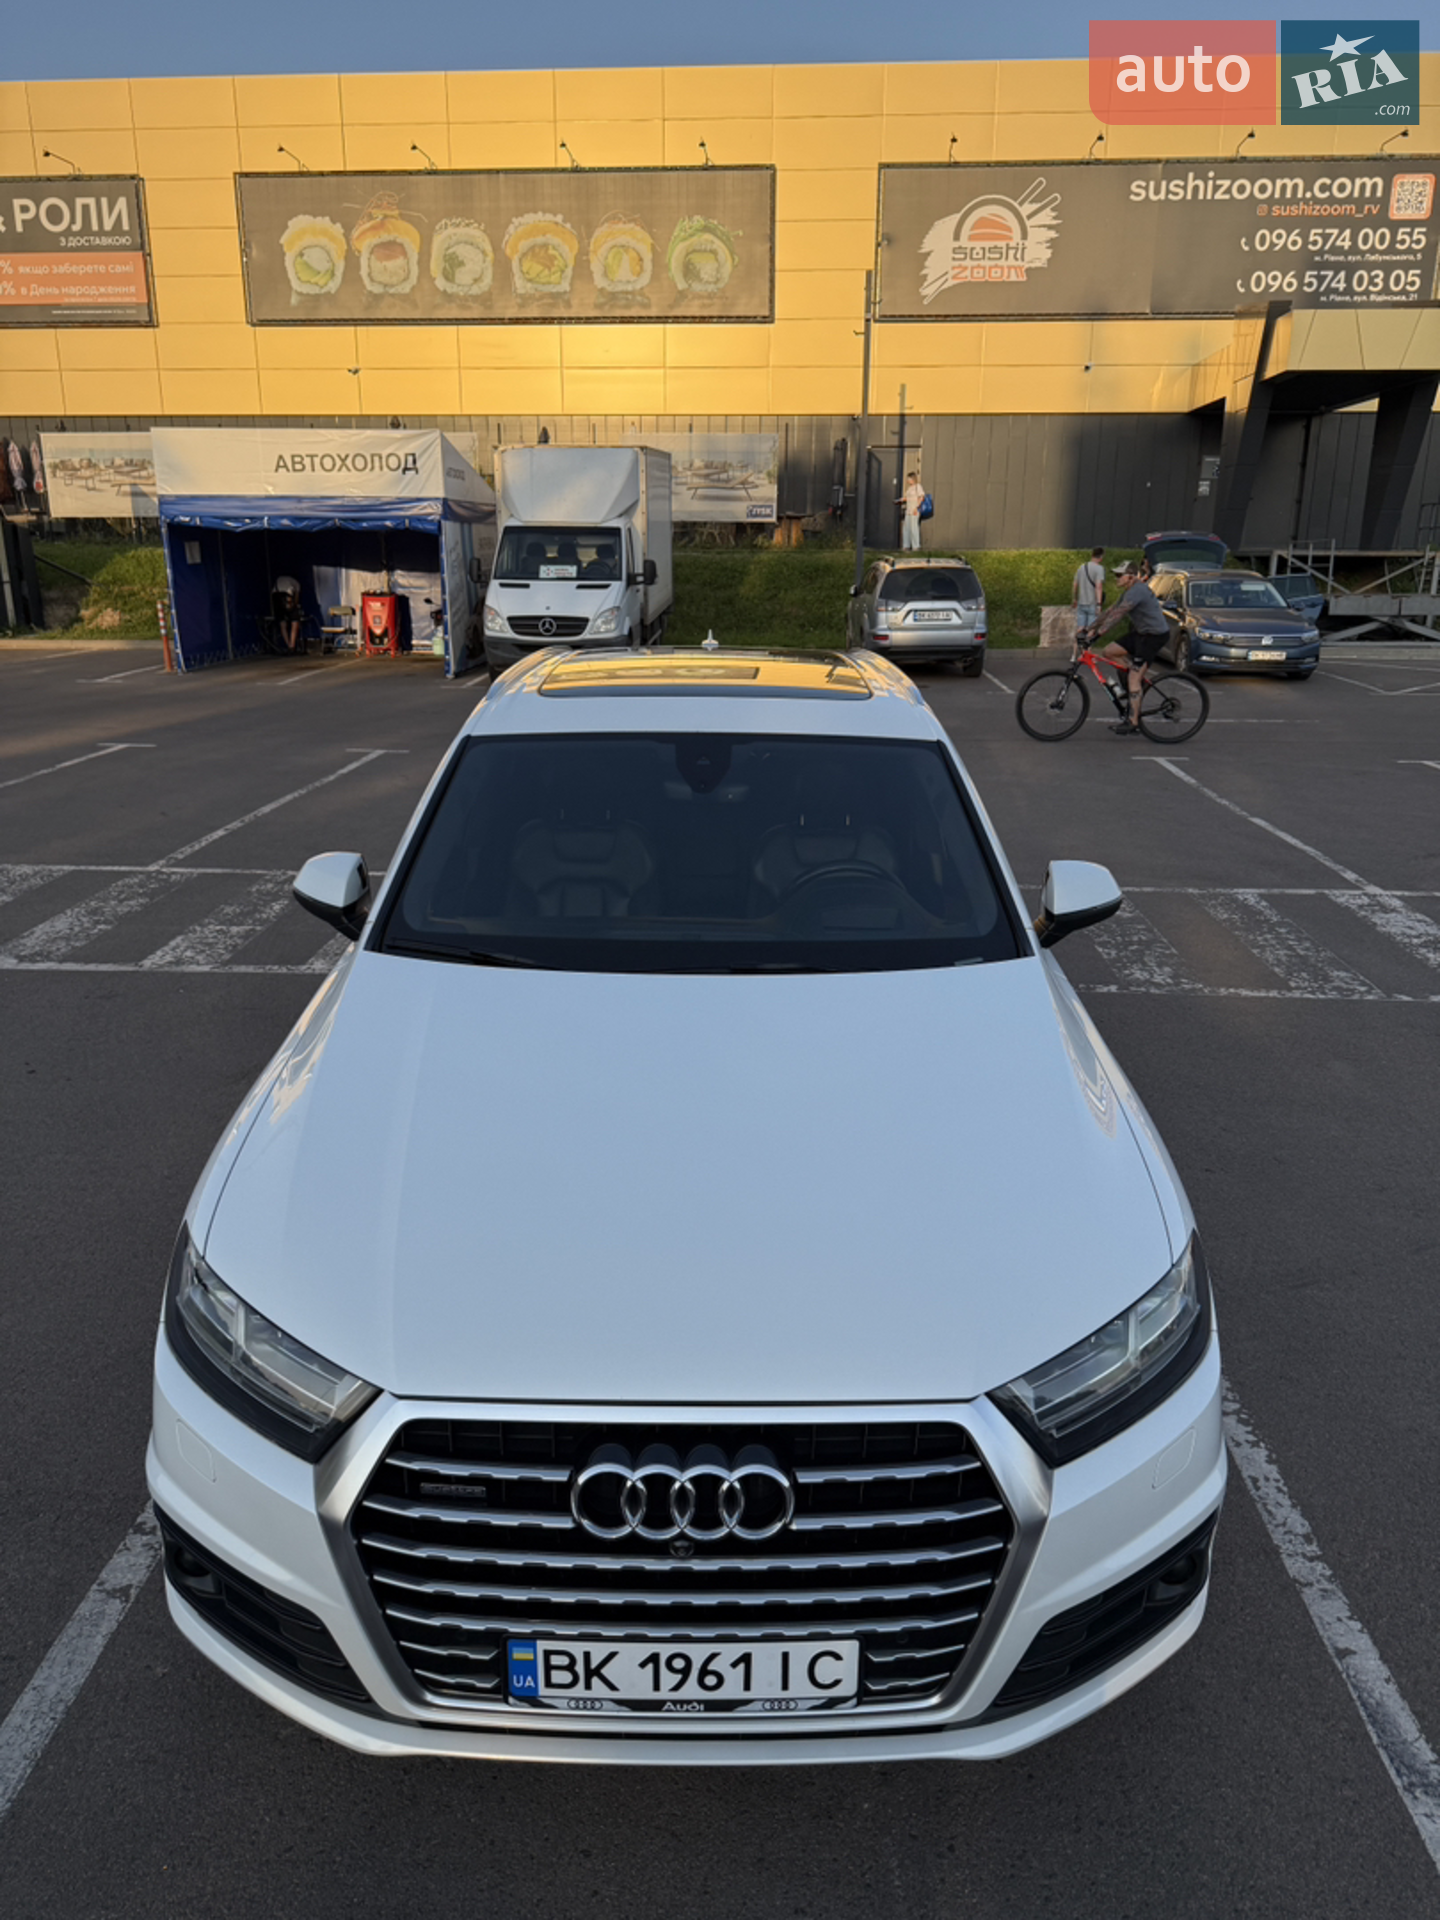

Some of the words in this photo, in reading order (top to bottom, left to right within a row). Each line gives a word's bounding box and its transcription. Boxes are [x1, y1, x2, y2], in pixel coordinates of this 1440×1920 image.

[1129, 171, 1384, 201] sushizoom.com
[12, 196, 130, 233] РОЛИ
[1271, 202, 1380, 218] sushizoom_rv
[67, 236, 132, 247] ДОСТАВКОЮ
[1254, 229, 1302, 251] 096
[1307, 229, 1352, 251] 574
[1357, 228, 1391, 250] 00
[1395, 227, 1427, 250] 55
[18, 264, 50, 275] якщо
[52, 263, 106, 276] заберете
[108, 262, 135, 274] самі
[30, 285, 60, 296] День
[61, 284, 136, 296] народження
[1250, 271, 1298, 293] 096
[1303, 270, 1347, 293] 574
[1352, 270, 1384, 292] 03
[1389, 270, 1421, 292] 05
[274, 453, 419, 475] АВТОХОЛОД
[543, 1649, 620, 1692] BK
[638, 1651, 752, 1692] 1961
[513, 1675, 535, 1688] UA
[661, 1701, 704, 1712] Audi
